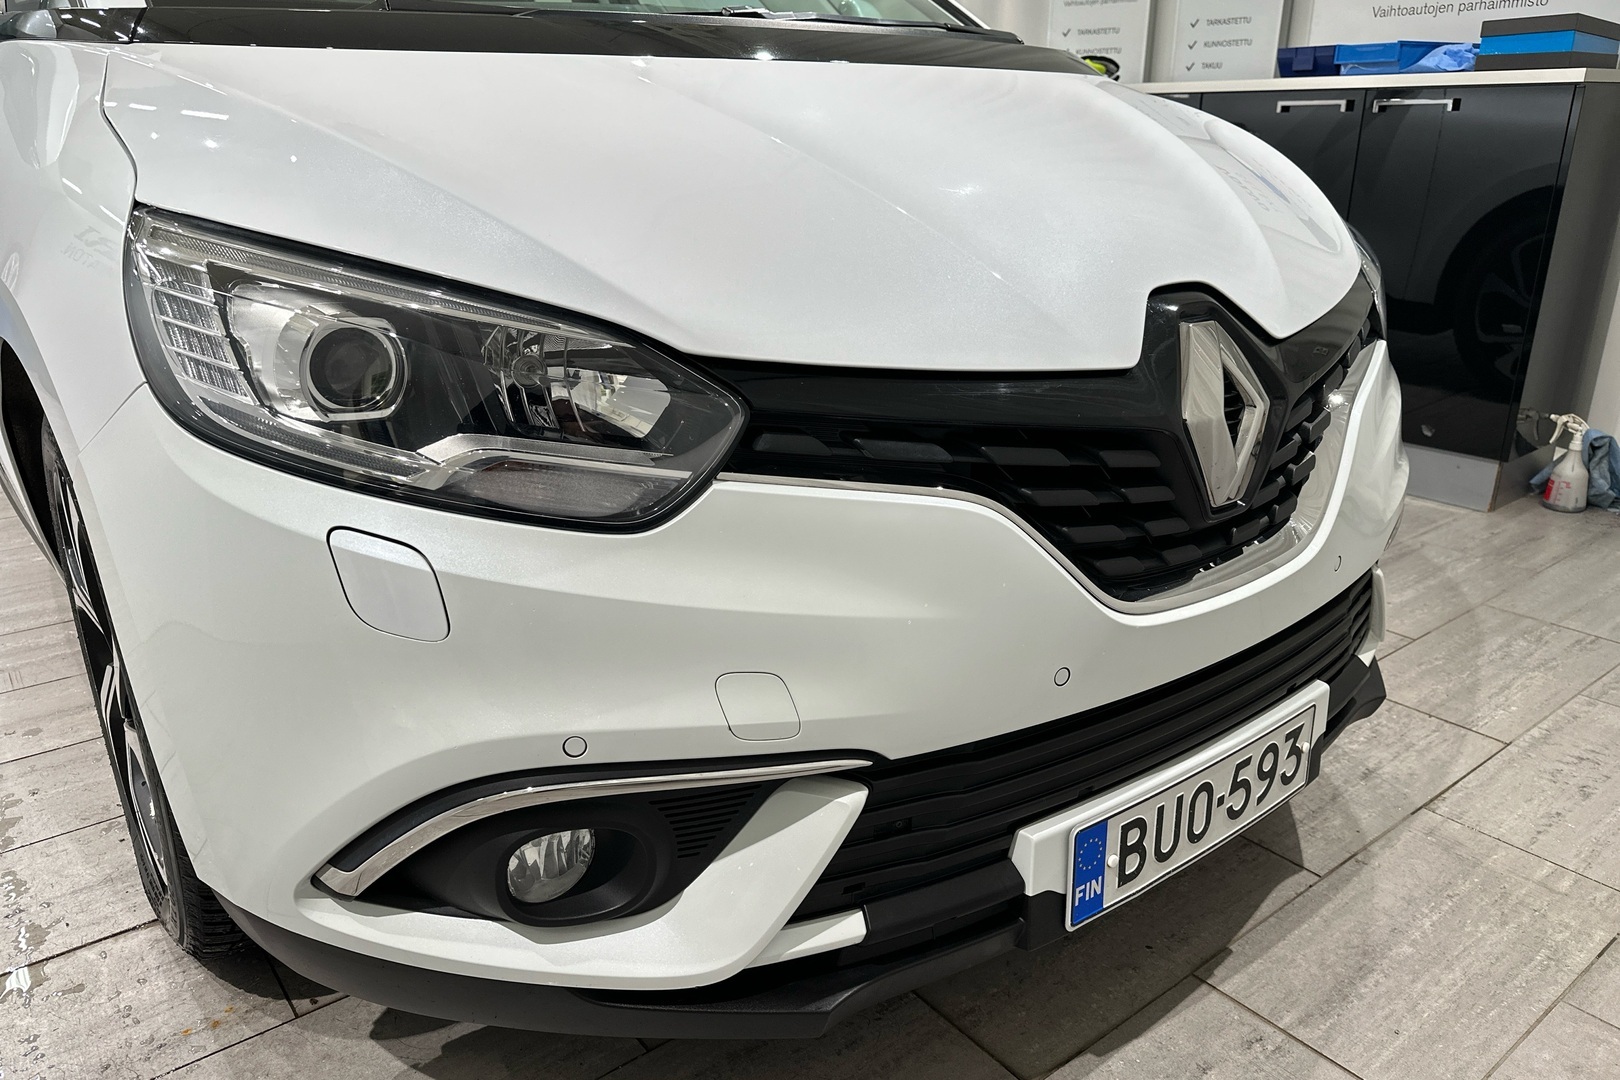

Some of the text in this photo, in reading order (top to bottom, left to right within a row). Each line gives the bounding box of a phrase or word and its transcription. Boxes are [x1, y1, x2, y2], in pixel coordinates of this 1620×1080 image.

[1372, 2, 1454, 18] Vaihtoautojen
[1206, 16, 1252, 26] TARKASTETTU
[1203, 38, 1252, 48] KUNNOSTETTU
[1201, 62, 1223, 70] TAKUU
[1117, 721, 1305, 888] BUO-593
[1074, 876, 1102, 907] FIN
